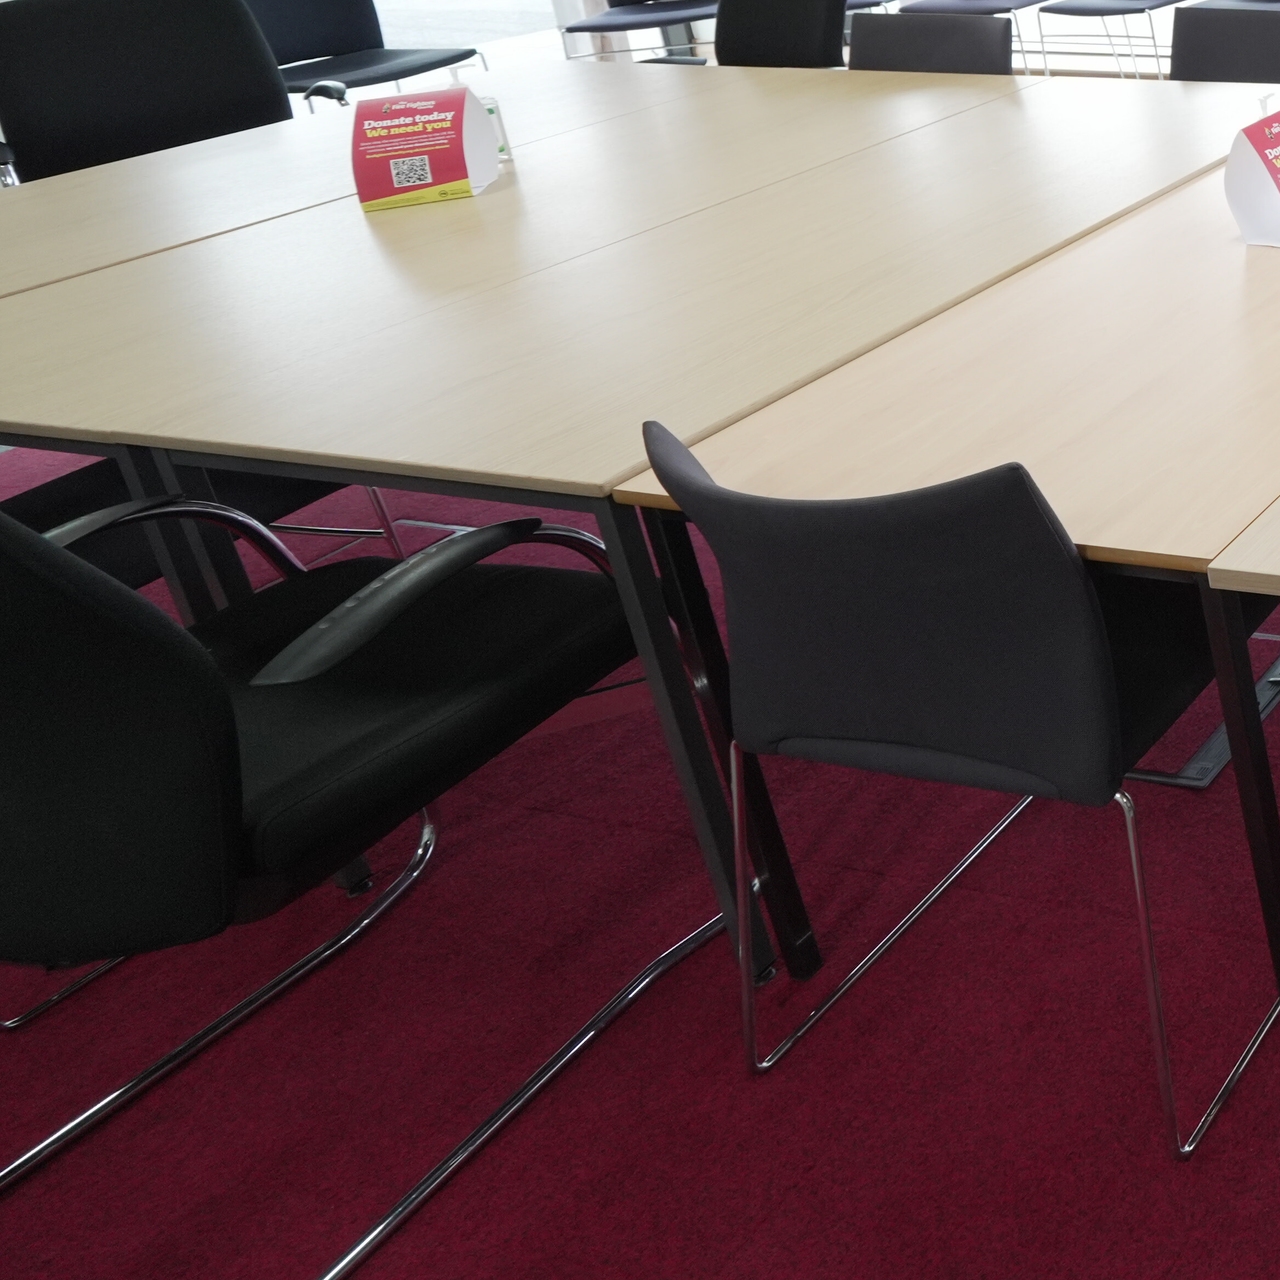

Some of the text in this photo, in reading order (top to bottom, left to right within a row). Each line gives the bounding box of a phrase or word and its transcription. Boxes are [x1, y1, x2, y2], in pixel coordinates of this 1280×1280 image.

[363, 111, 455, 130] Donate today
[365, 121, 451, 138] We need you
